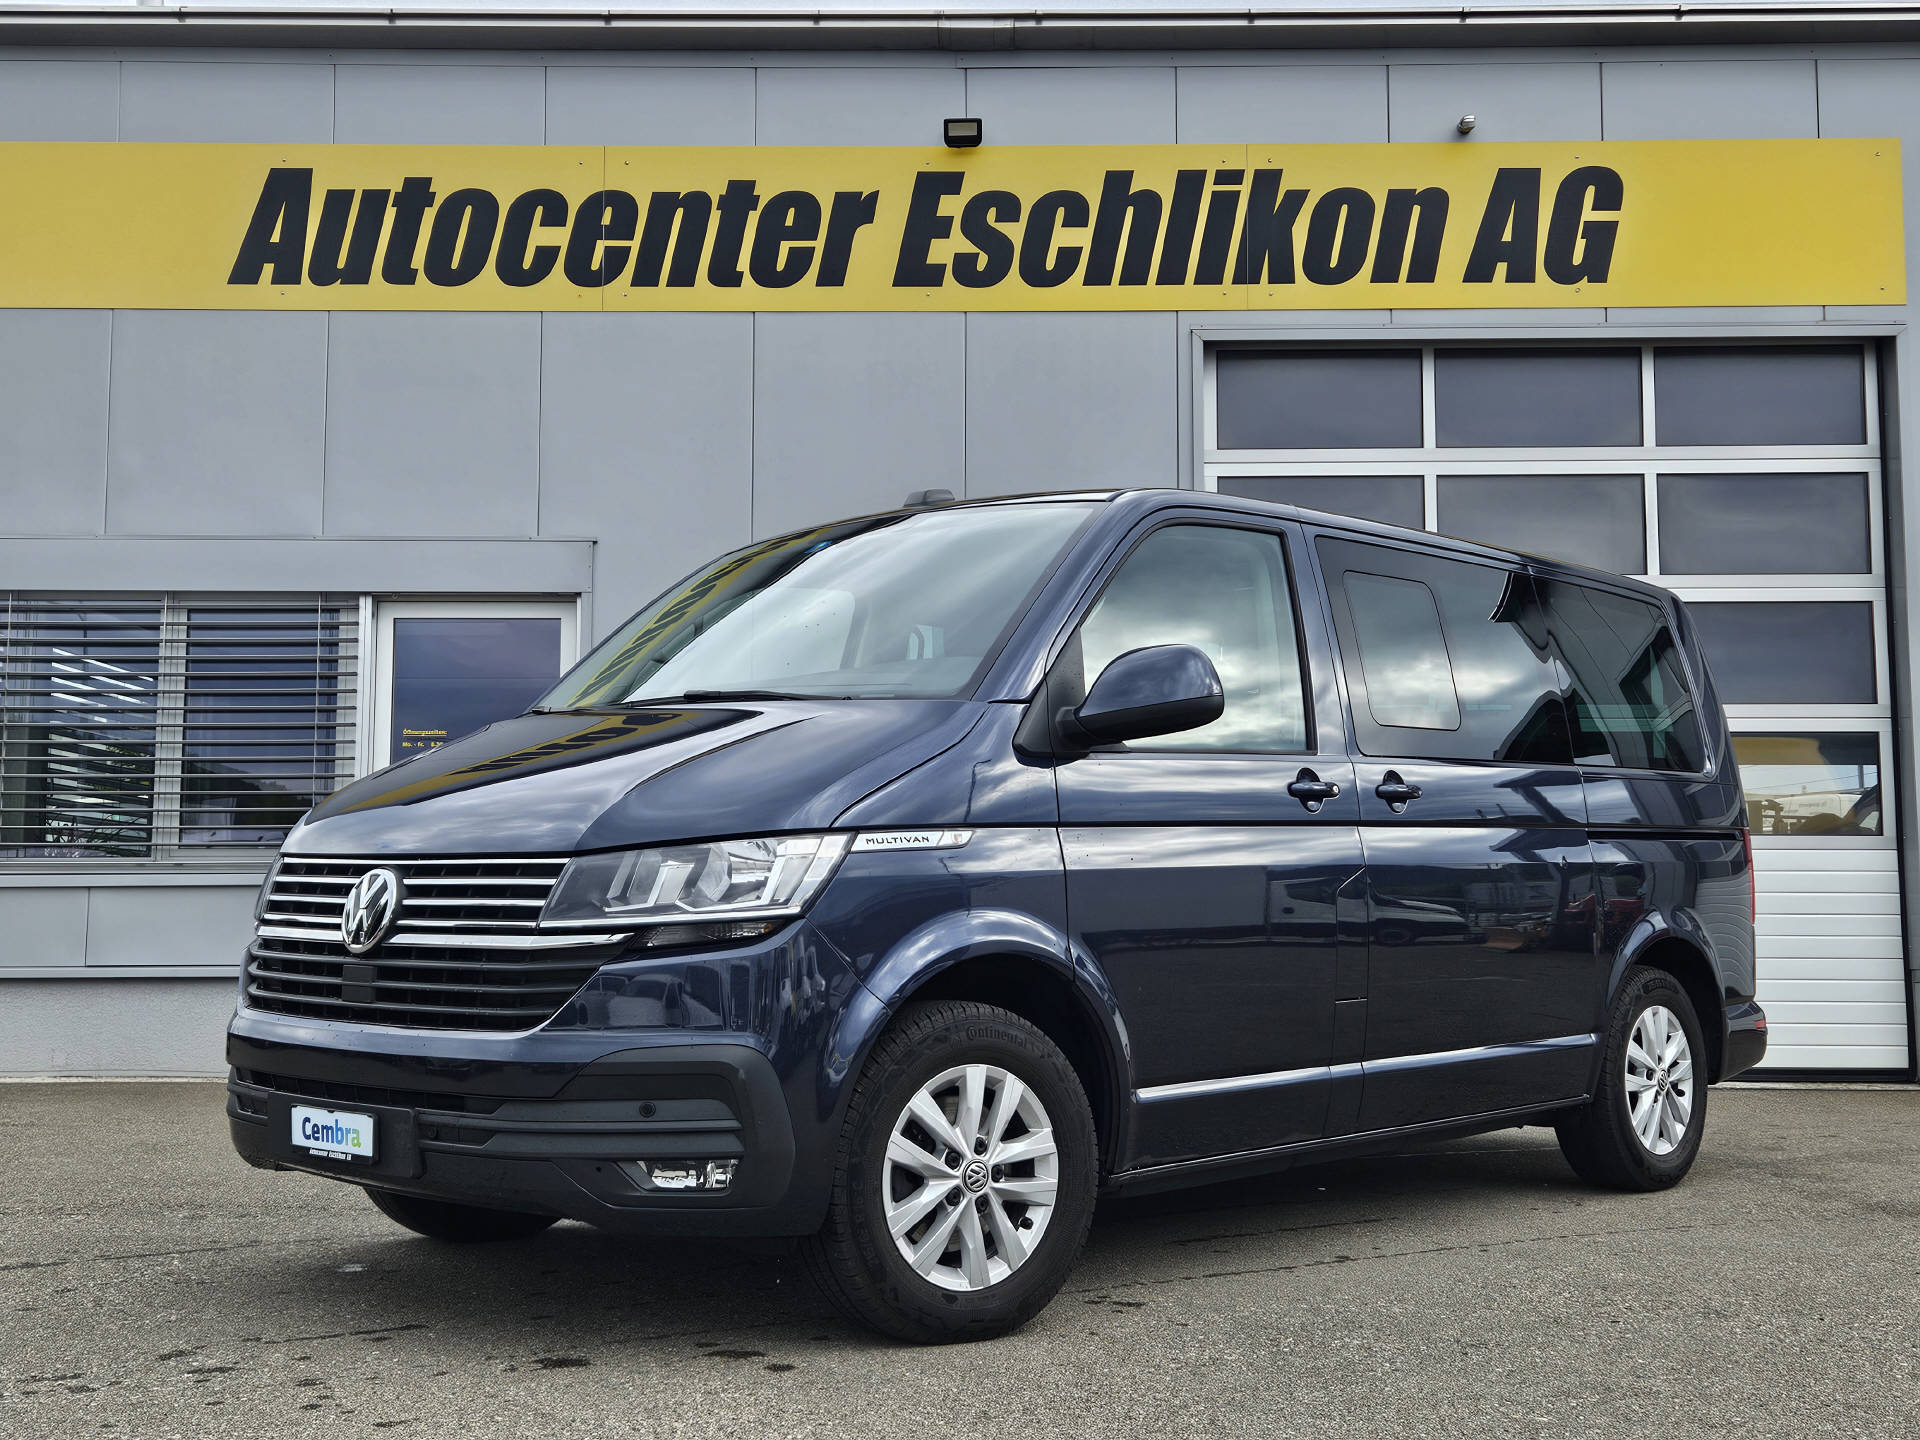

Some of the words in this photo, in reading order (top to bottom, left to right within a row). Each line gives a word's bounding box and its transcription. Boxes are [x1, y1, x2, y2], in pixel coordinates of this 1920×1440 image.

[227, 168, 879, 288] Autocenter
[891, 169, 1449, 288] Eschlikon
[1463, 166, 1623, 285] AG
[865, 836, 930, 845] MULTIVAN
[302, 1116, 361, 1148] Cembra
